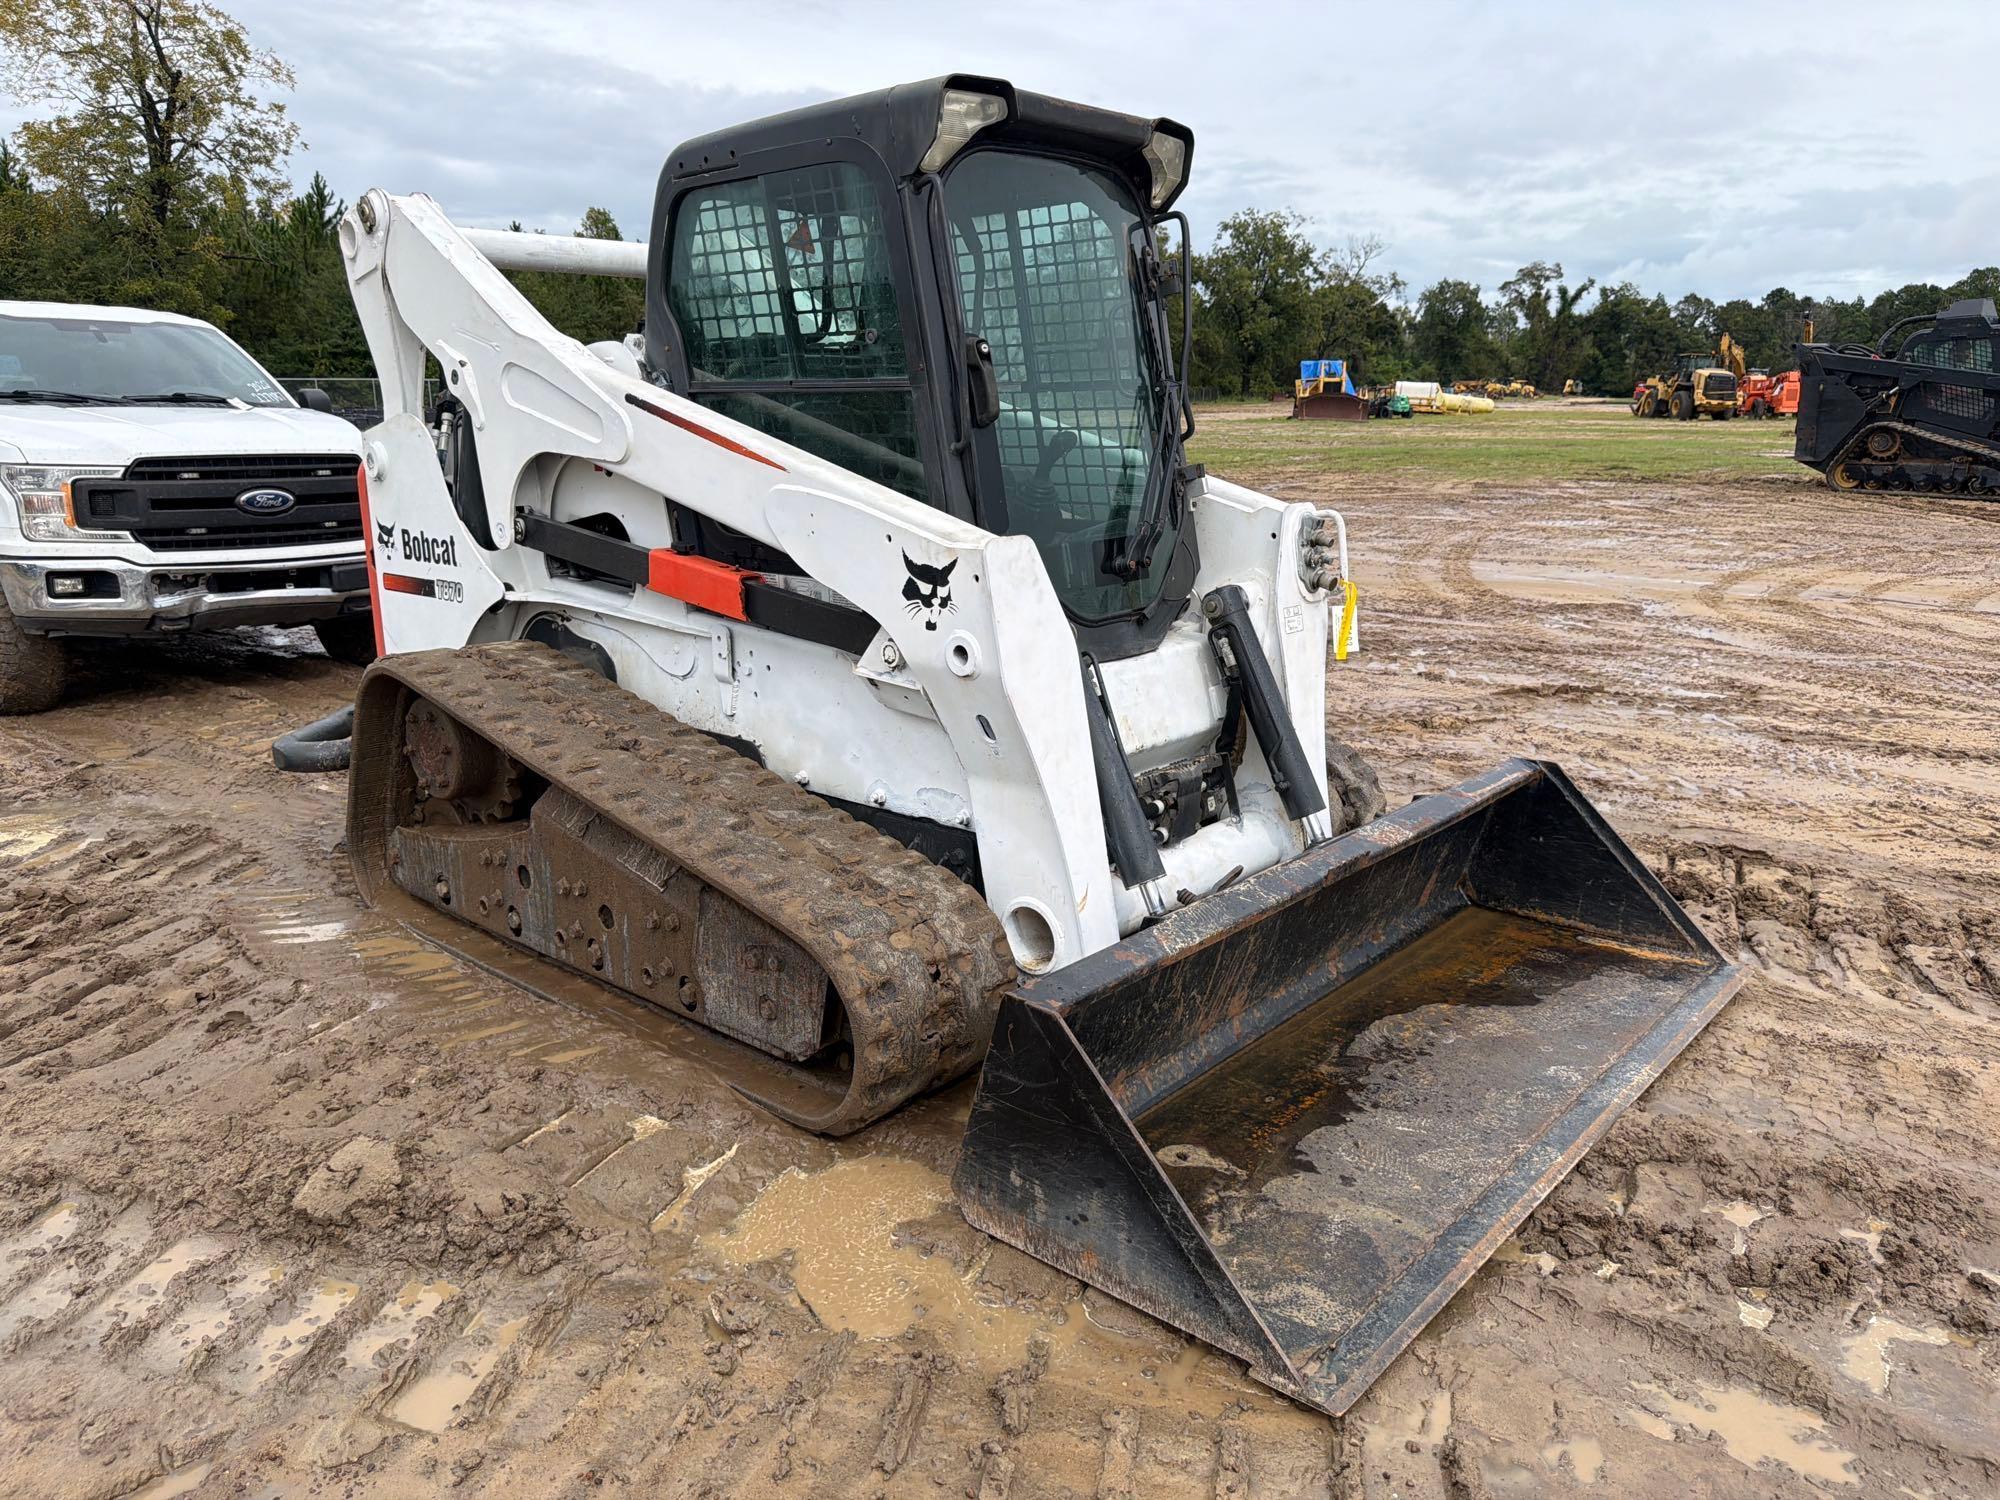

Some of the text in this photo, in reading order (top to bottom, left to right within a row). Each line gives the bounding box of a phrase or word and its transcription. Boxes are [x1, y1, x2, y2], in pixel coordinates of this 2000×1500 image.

[254, 494, 282, 506] Ford
[401, 528, 457, 567] Bobcat
[436, 579, 463, 603] T870
